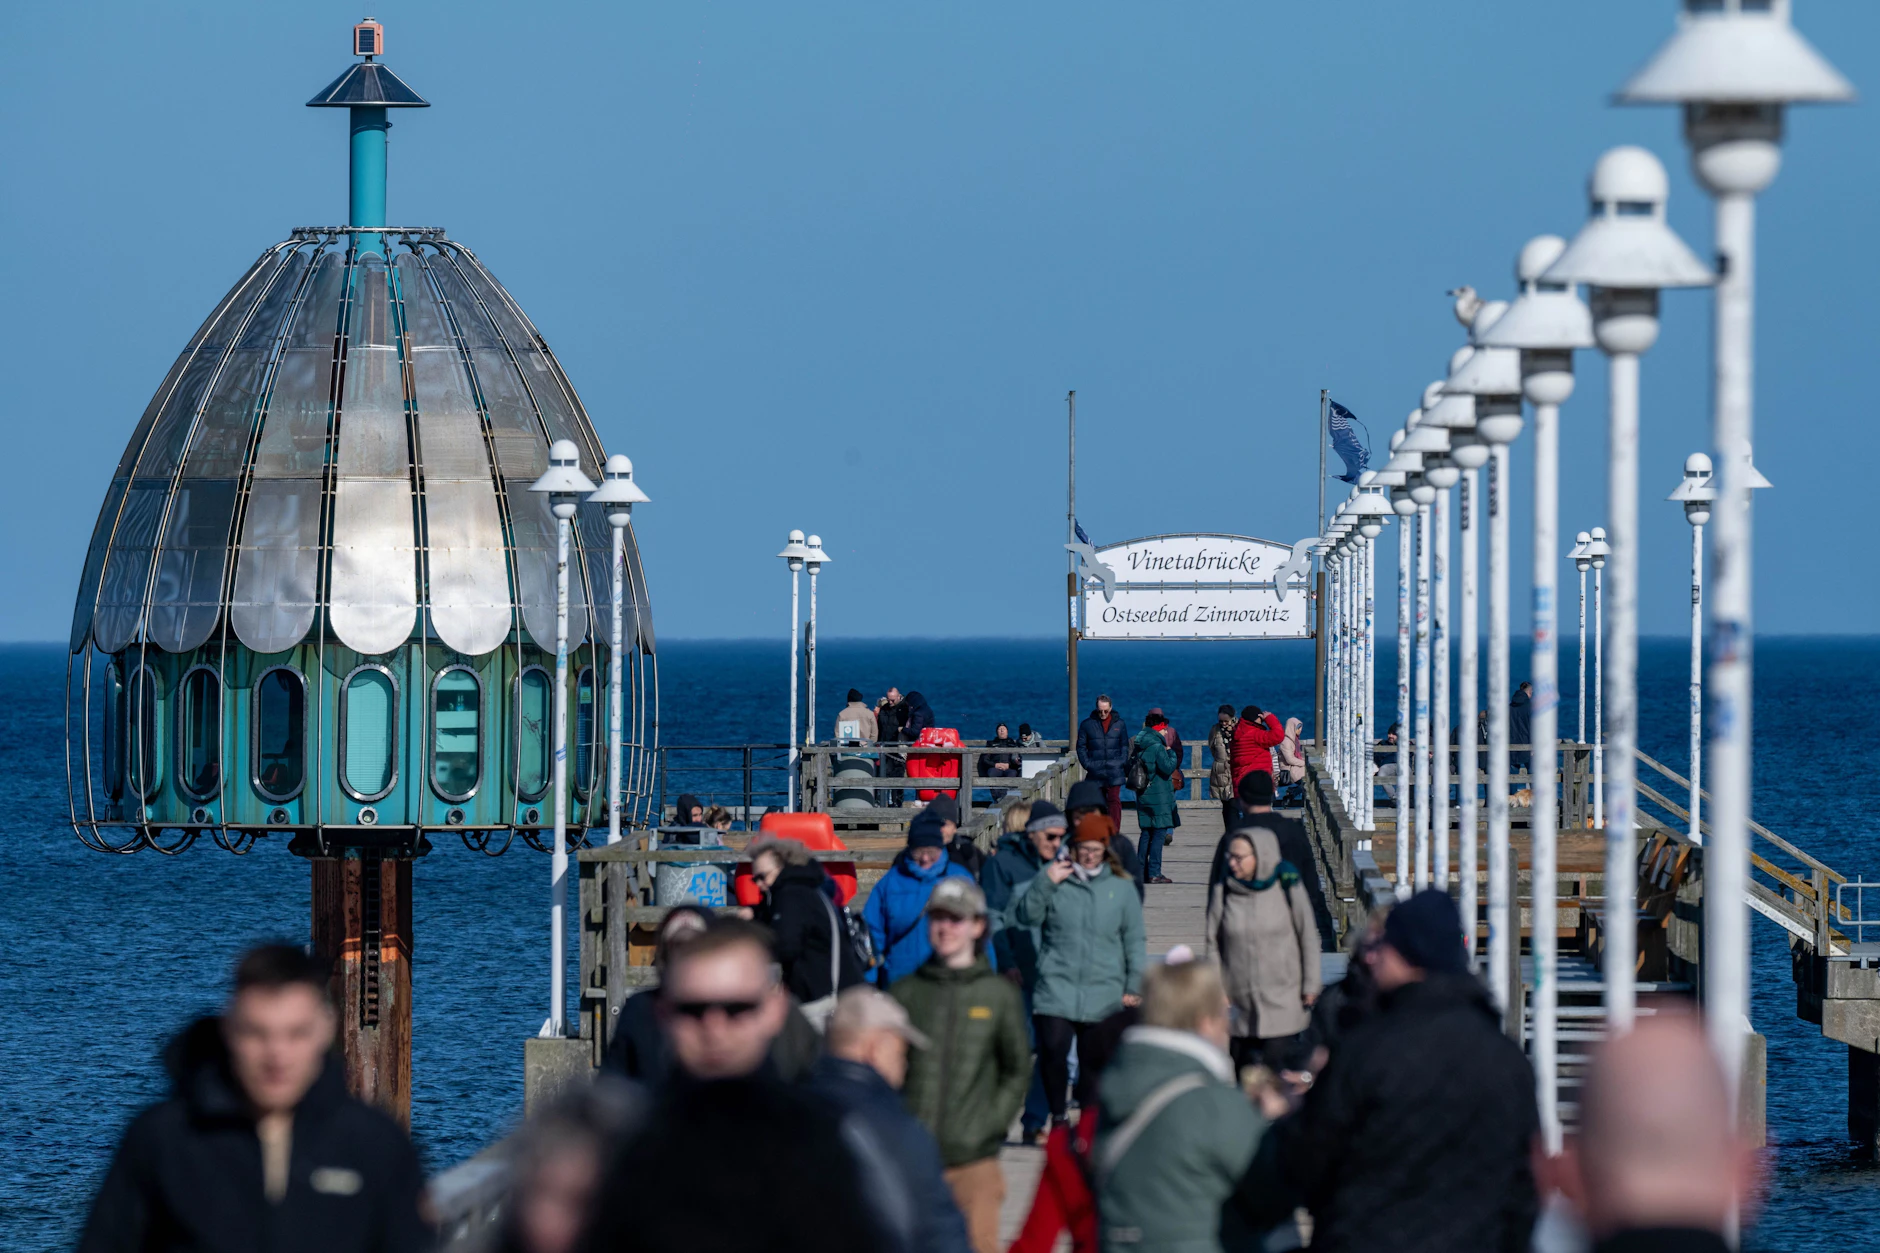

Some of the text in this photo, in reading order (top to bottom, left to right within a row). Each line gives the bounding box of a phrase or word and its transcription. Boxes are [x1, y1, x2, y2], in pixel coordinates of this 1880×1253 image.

[1127, 549, 1261, 575] Vinetabrücke
[1102, 603, 1290, 623] Ostseebad Zinnowitz
